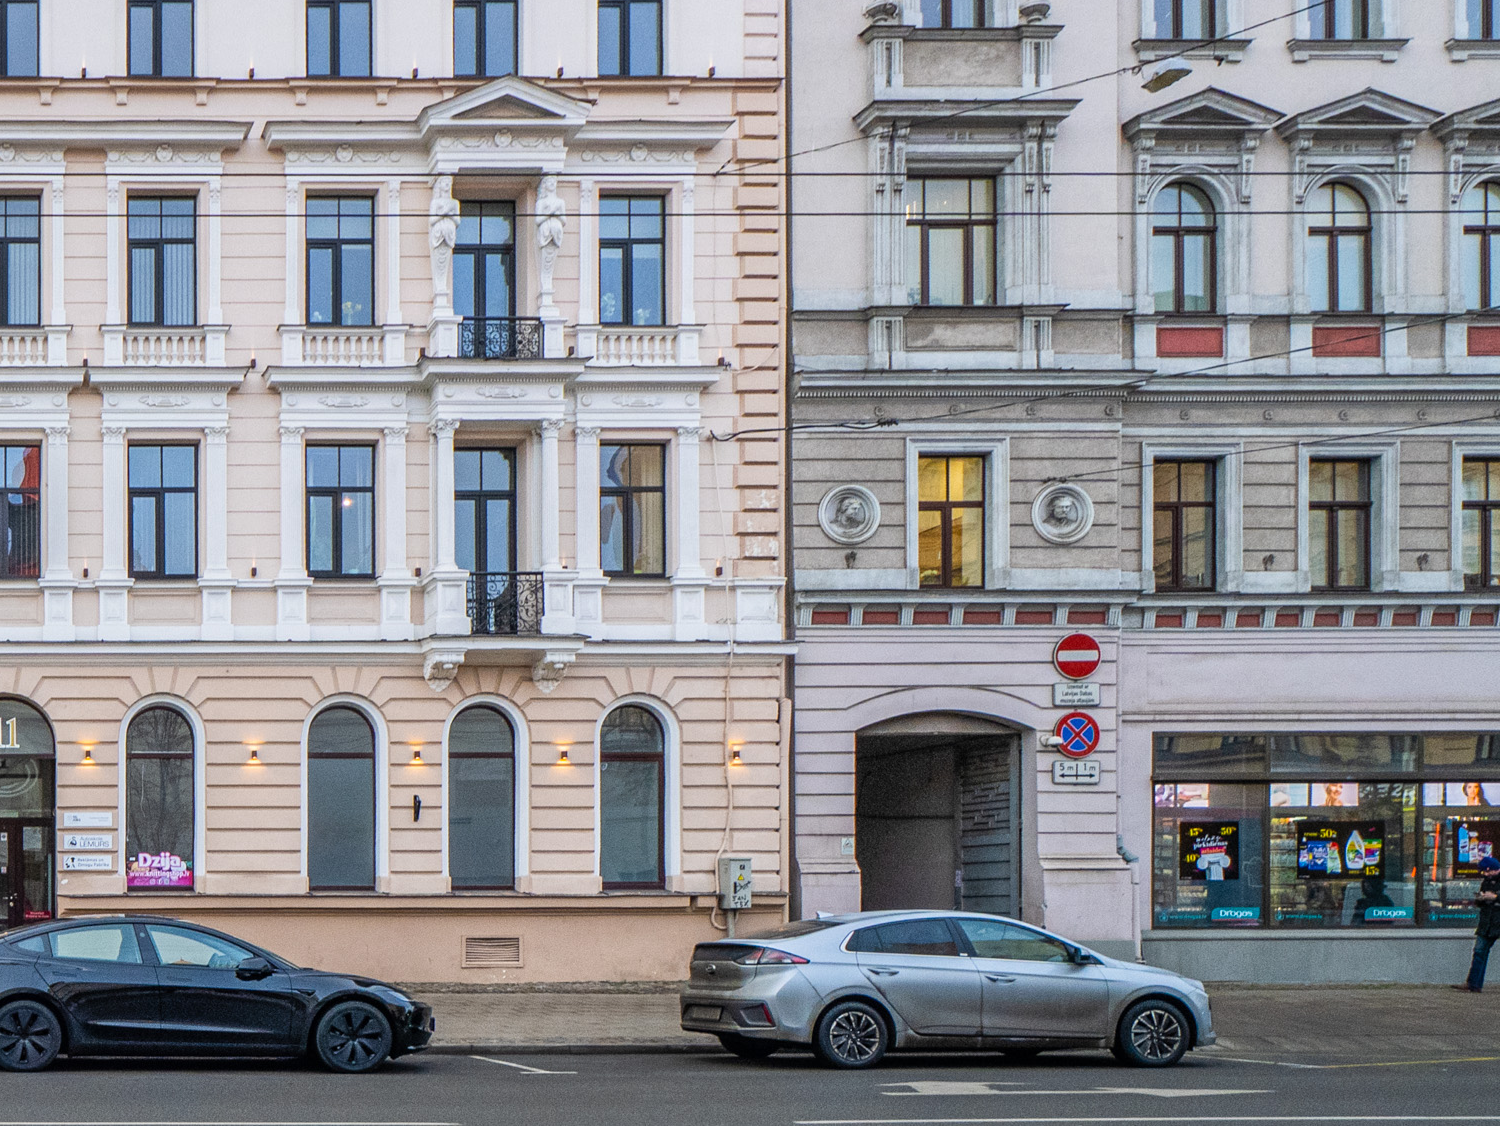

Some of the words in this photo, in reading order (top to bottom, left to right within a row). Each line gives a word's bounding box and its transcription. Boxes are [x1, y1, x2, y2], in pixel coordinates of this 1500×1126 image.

[1060, 763, 1065, 771] 5
[1083, 763, 1088, 771] 1
[138, 851, 181, 871] Dzija
[1220, 909, 1253, 918] Drogas
[1373, 909, 1406, 917] Drogas
